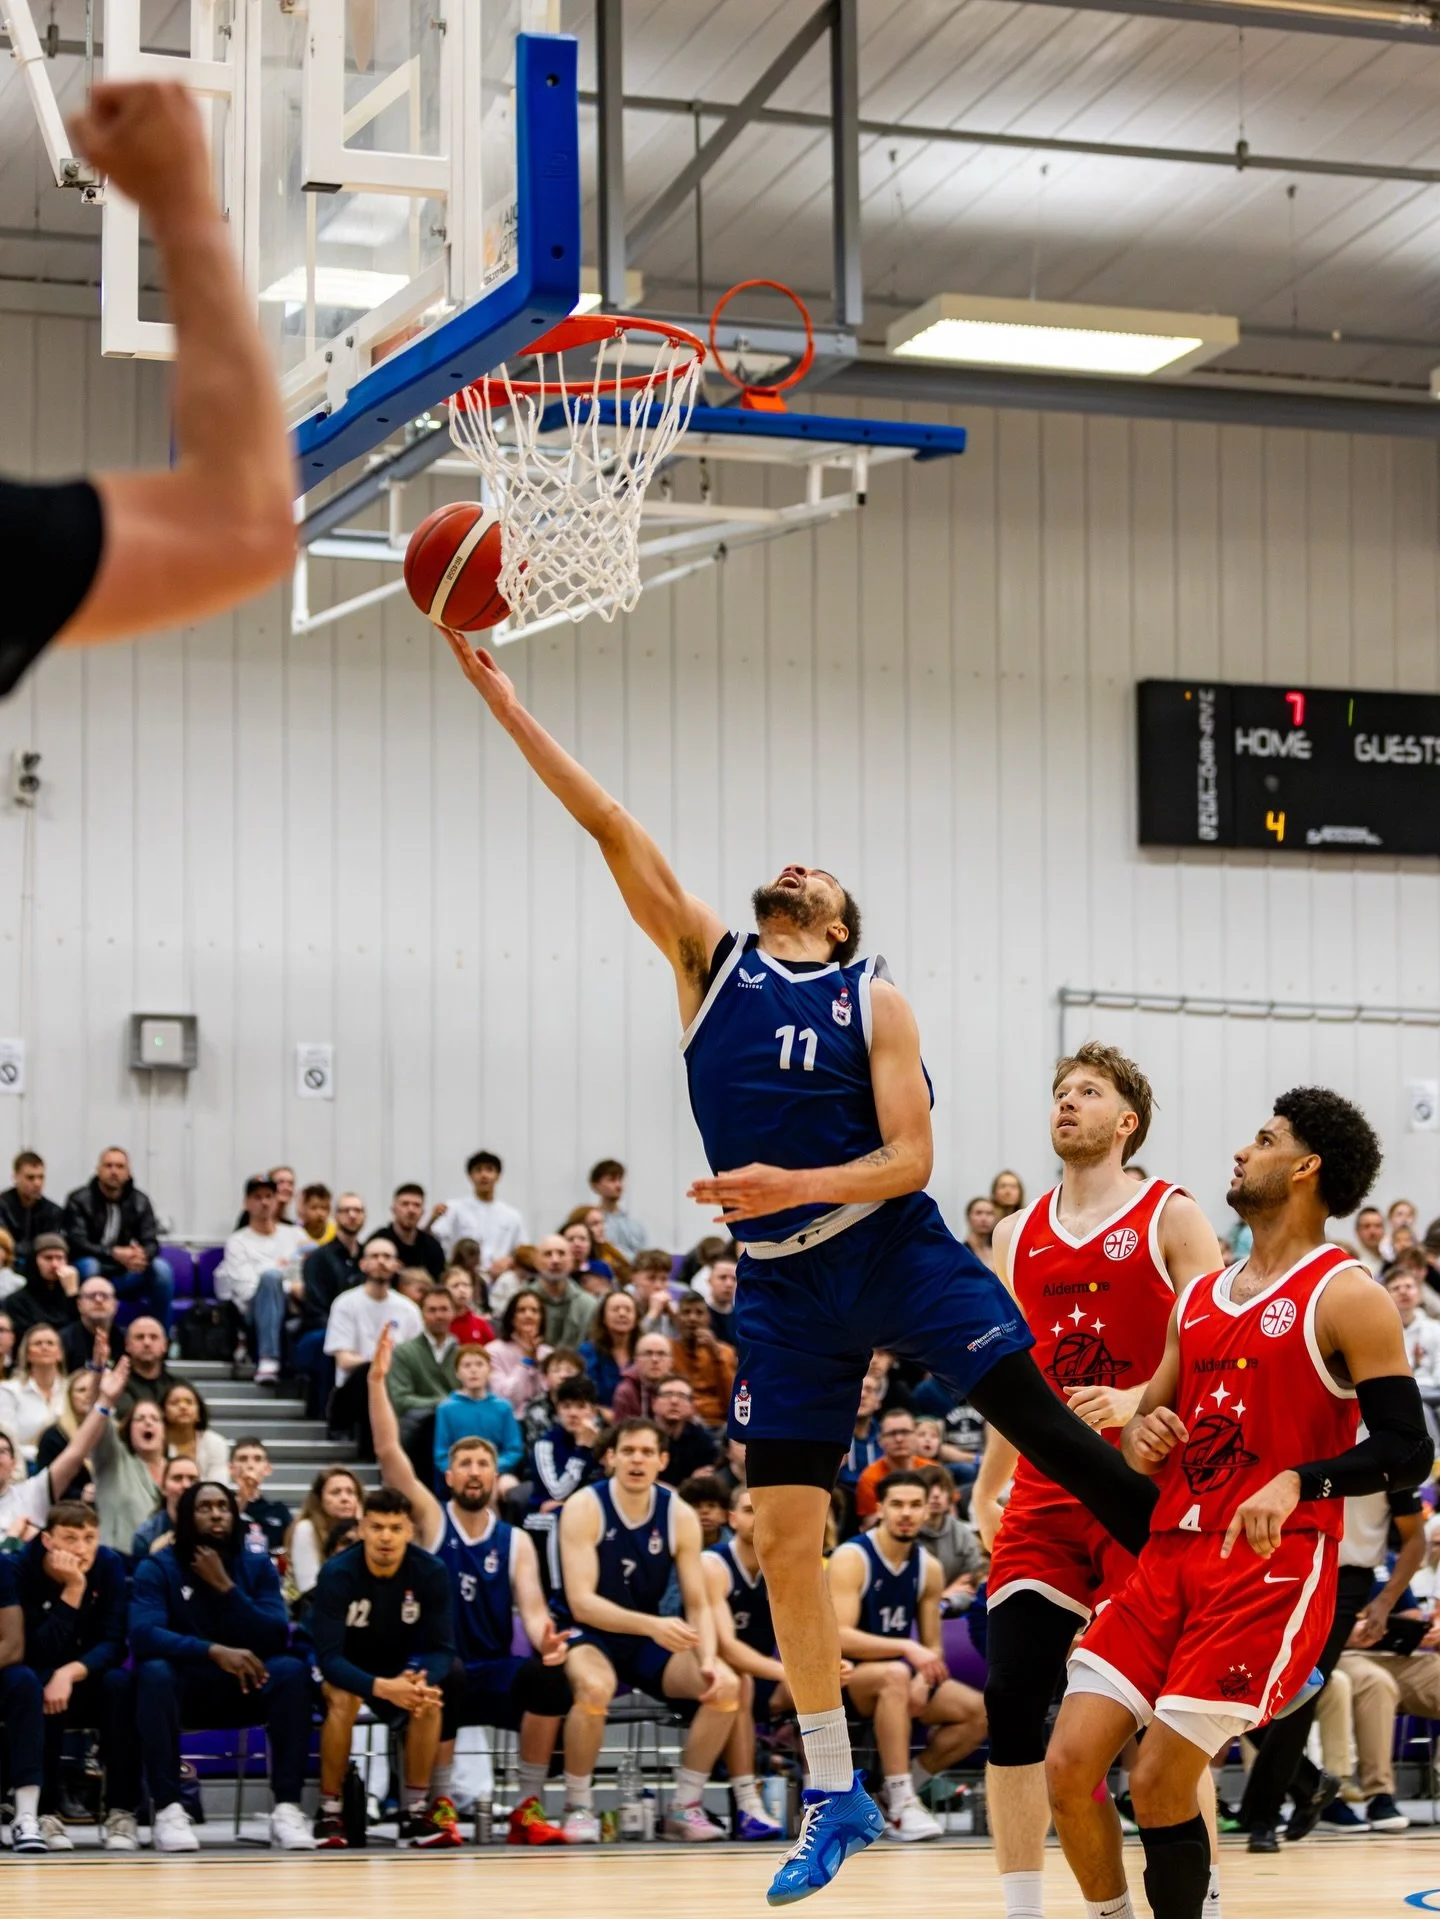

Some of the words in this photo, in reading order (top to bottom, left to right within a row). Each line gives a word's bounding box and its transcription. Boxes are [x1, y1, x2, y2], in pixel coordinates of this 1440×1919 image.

[1284, 691, 1306, 727] 7
[1235, 727, 1312, 758] HOME
[1265, 810, 1286, 842] 4
[775, 1024, 818, 1071] 11
[1043, 1281, 1110, 1297] Aldermore
[1193, 1357, 1259, 1373] Aldermore
[1178, 1503, 1202, 1532] 4
[620, 1557, 637, 1585] 7
[345, 1598, 373, 1628] 12
[879, 1605, 908, 1633] 14
